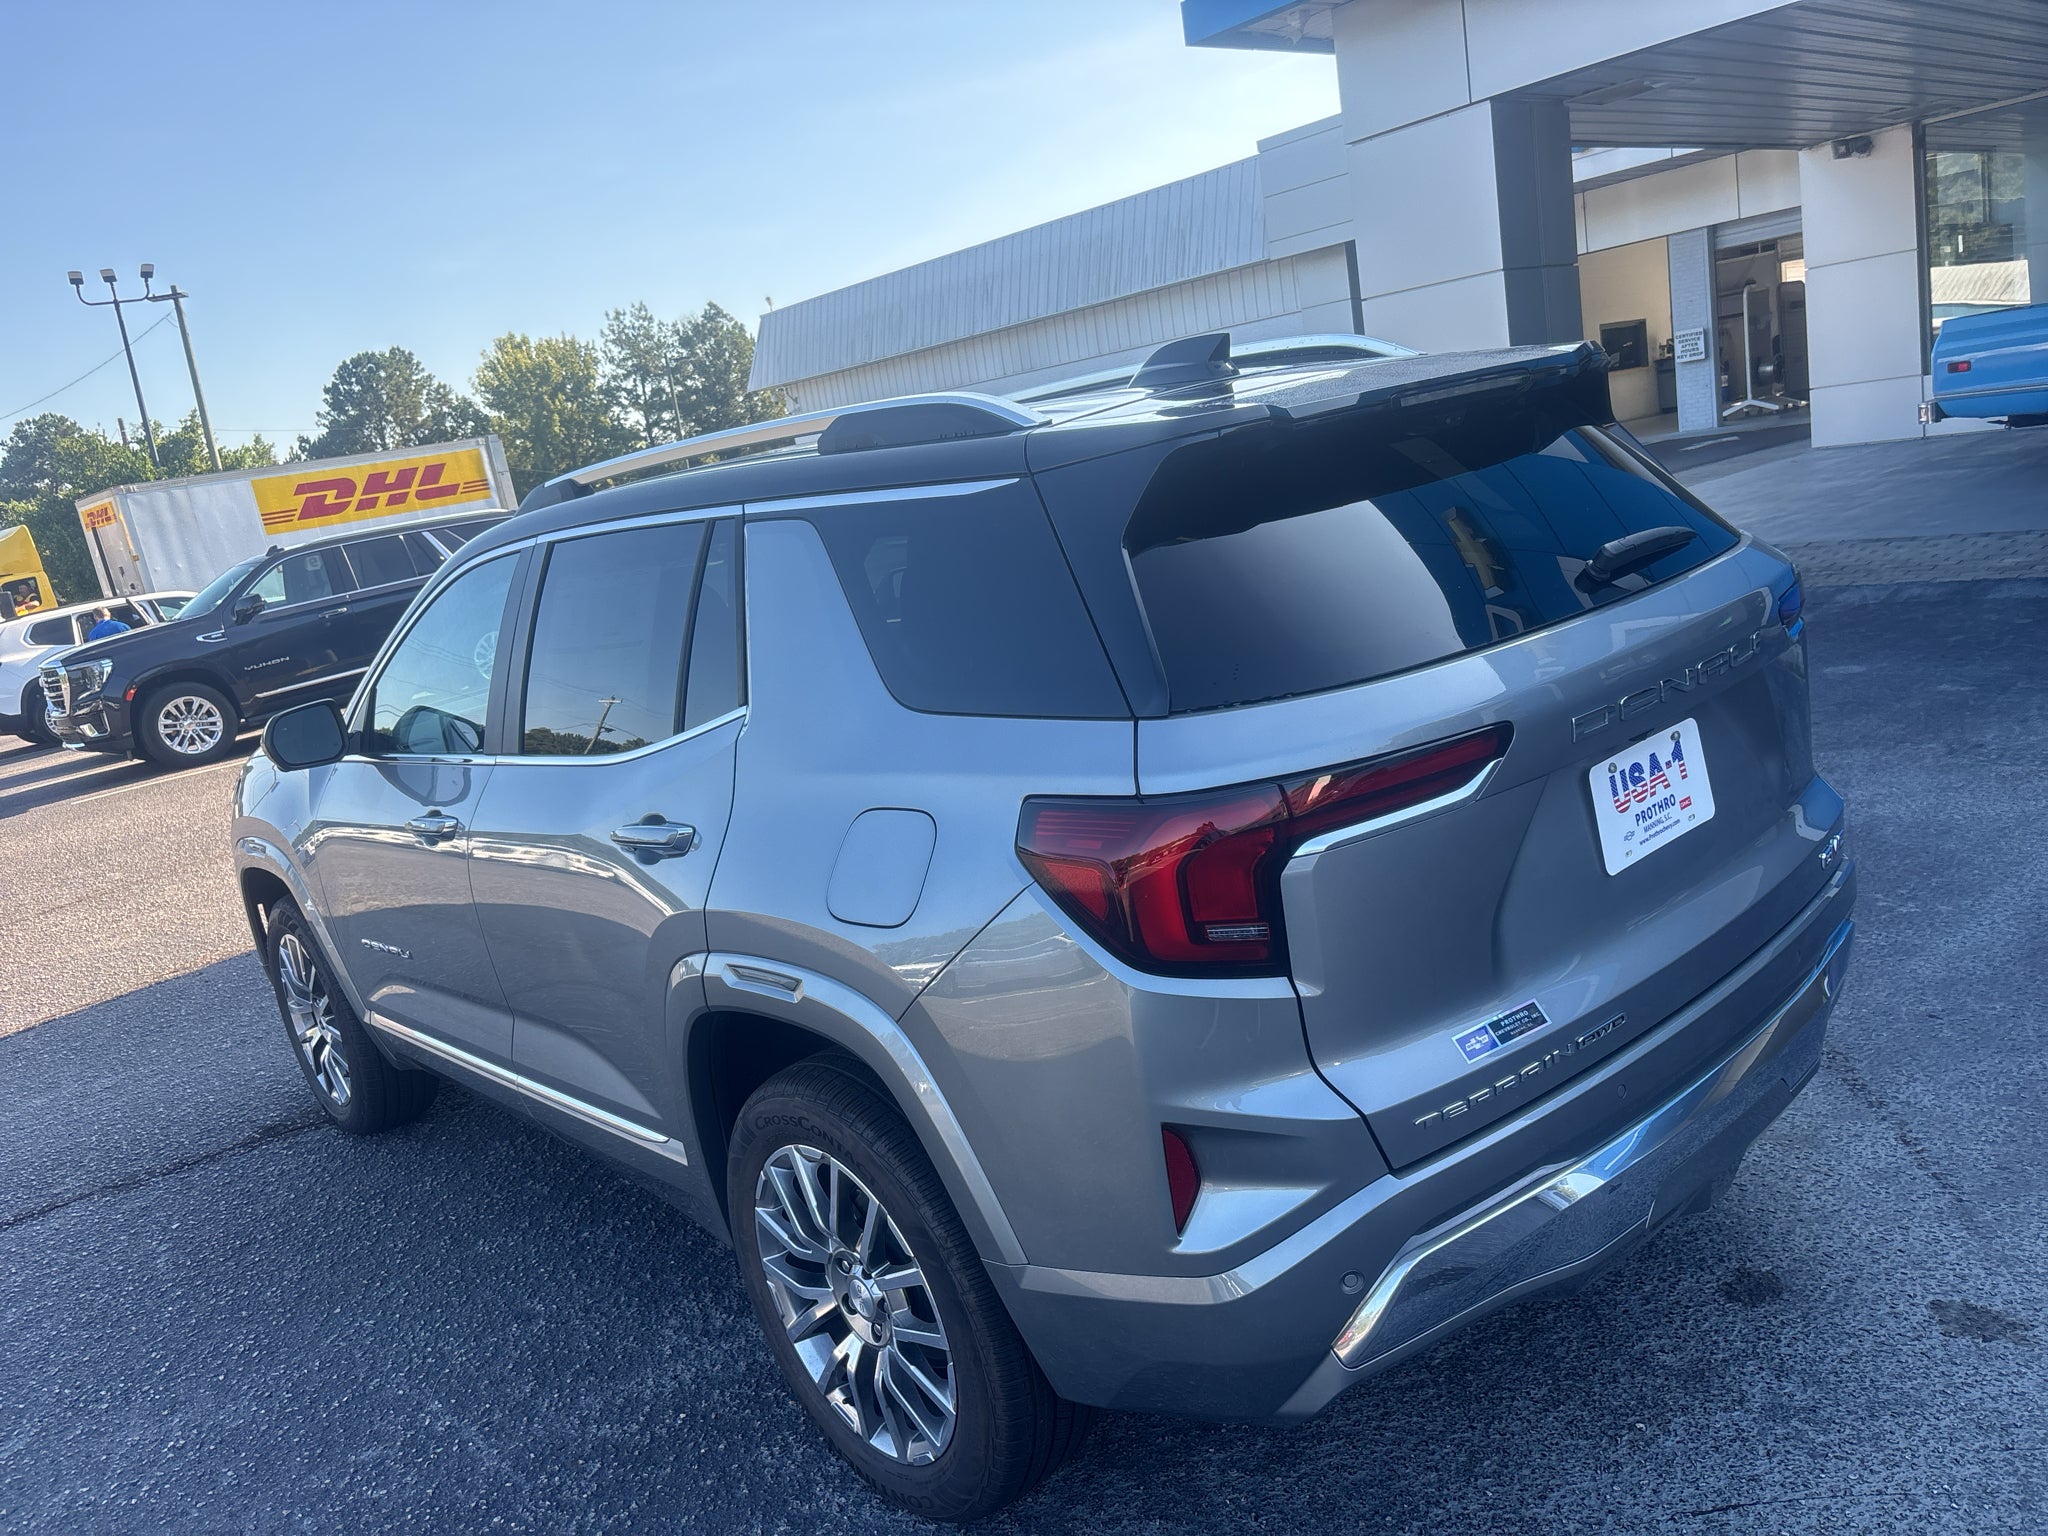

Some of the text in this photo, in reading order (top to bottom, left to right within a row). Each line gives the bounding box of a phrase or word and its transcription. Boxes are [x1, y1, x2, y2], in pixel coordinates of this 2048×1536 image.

[1676, 331, 1702, 340] CERTIFIED
[293, 462, 461, 521] DHL
[86, 506, 112, 527] DHL
[243, 655, 290, 671] YUKON
[1608, 739, 1689, 814] USA-1
[1634, 793, 1677, 827] PROTHRO
[1495, 1020, 1521, 1036] CHEVROLET
[1500, 1010, 1529, 1027] PROTHRO
[1576, 1011, 1627, 1051] AWD
